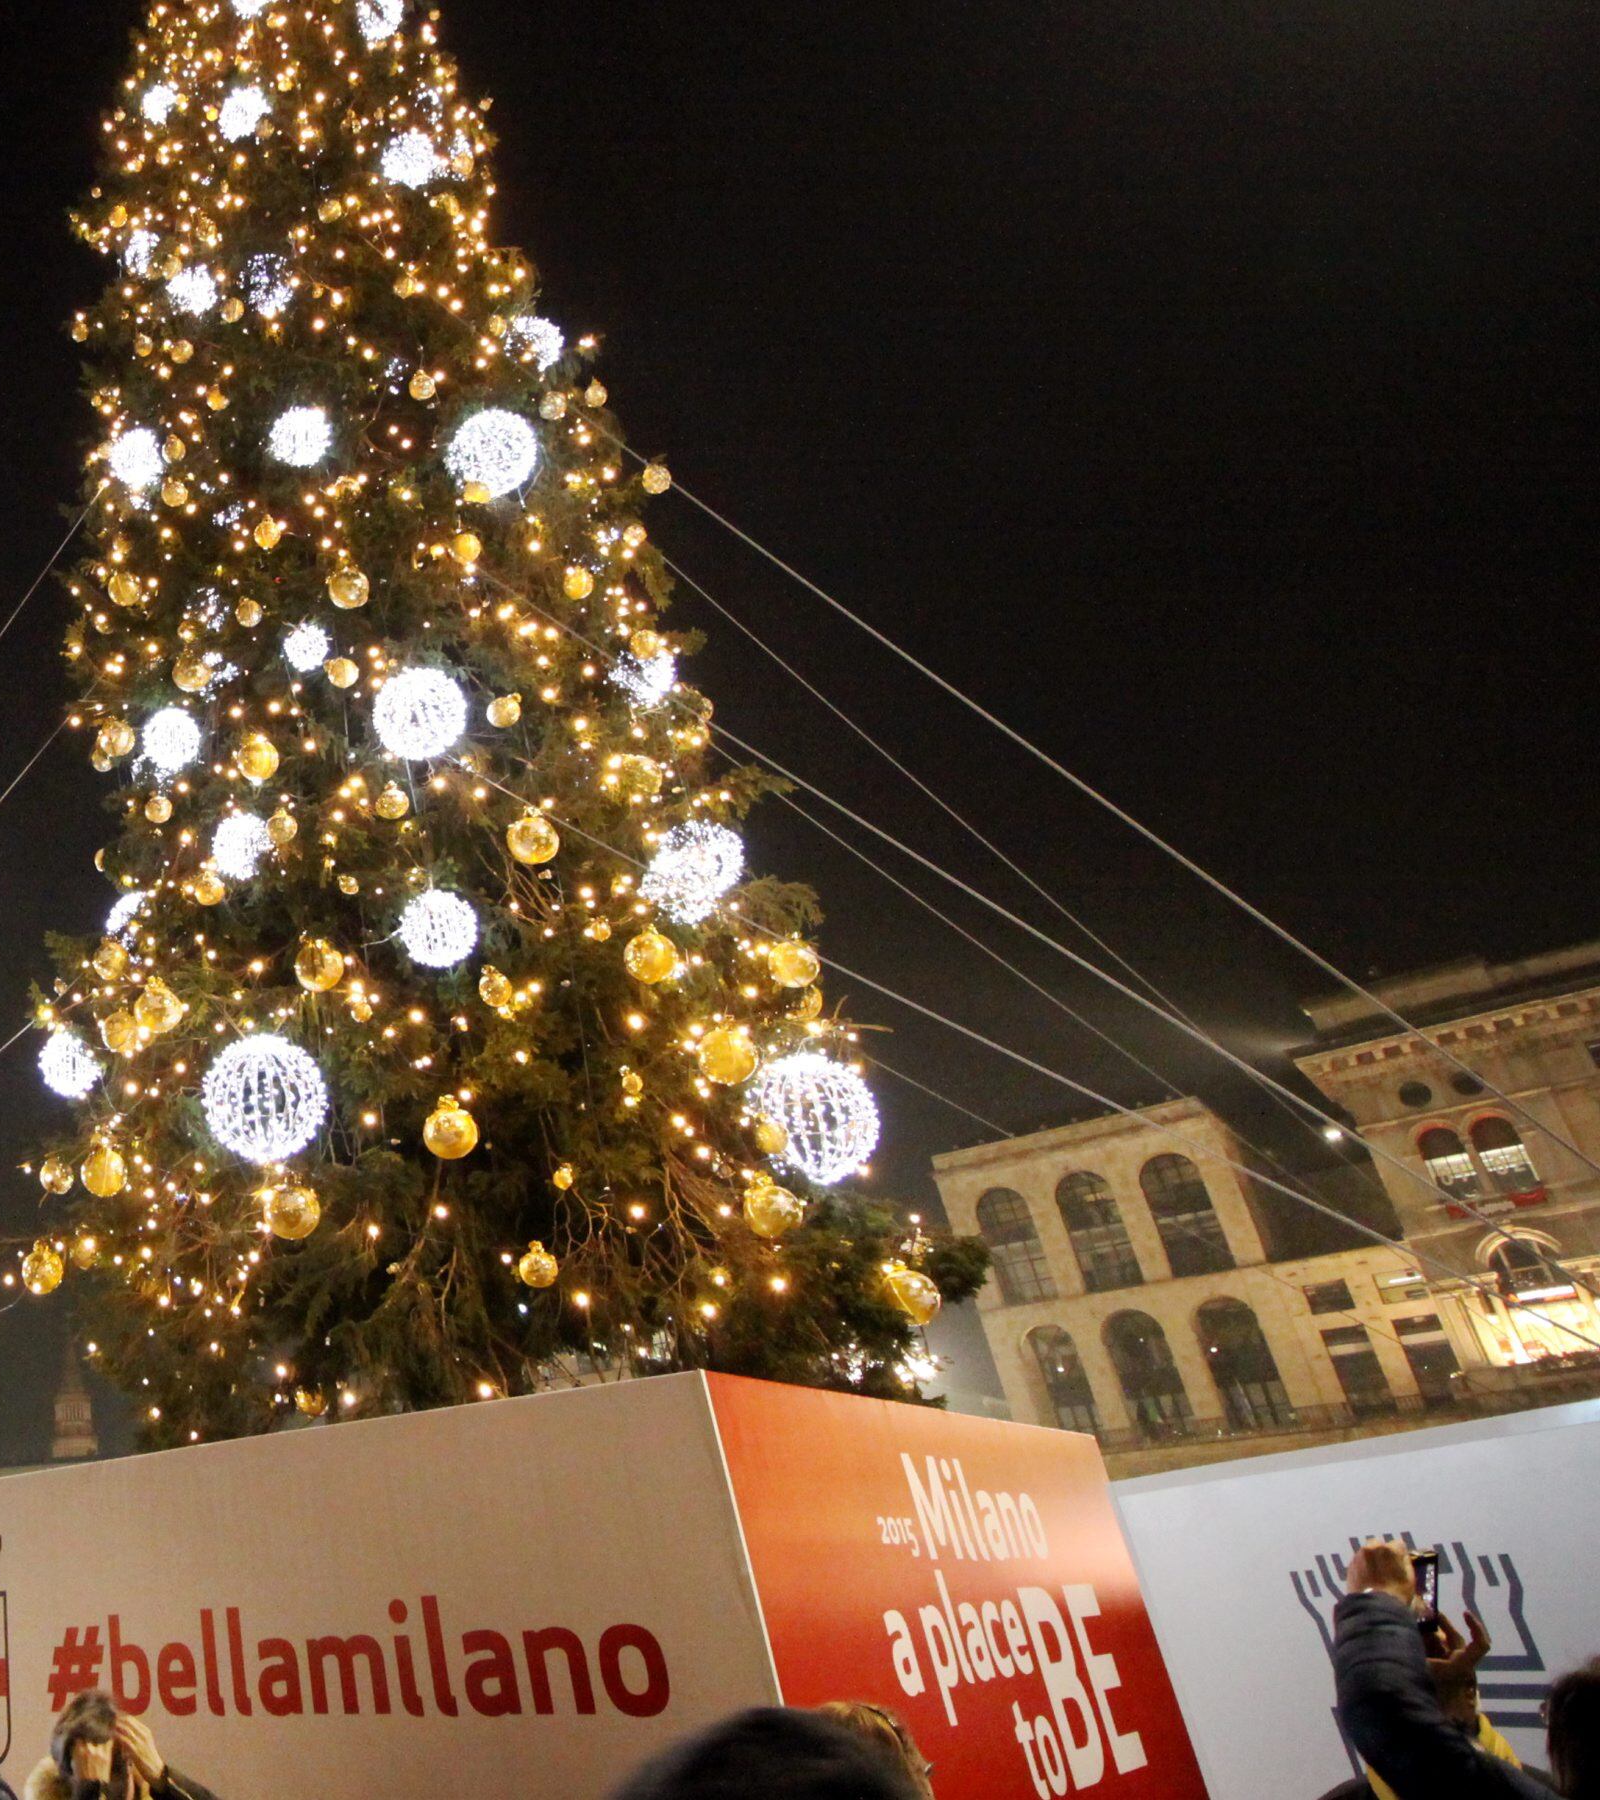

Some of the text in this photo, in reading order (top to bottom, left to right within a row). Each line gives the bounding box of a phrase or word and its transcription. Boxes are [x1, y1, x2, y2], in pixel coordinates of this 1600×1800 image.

[876, 1452, 1049, 1562] 2015 Milano
[47, 1595, 671, 1718] #bellamilano
[883, 1569, 1034, 1727] a place
[1012, 1584, 1148, 1800] to BE
